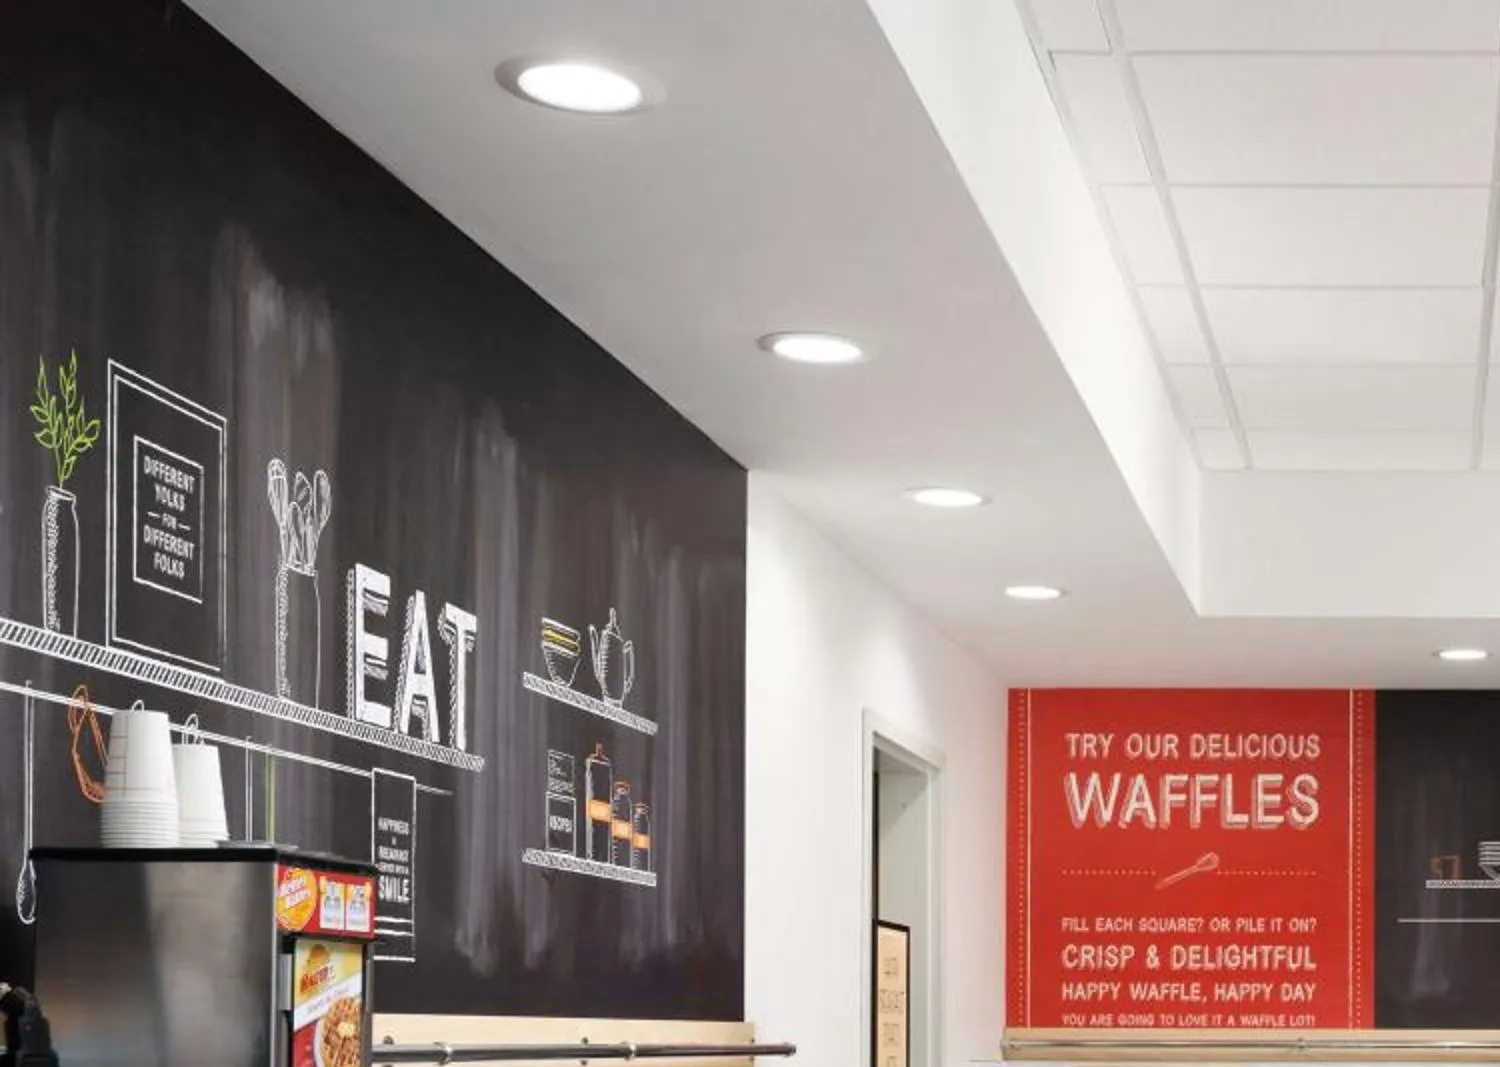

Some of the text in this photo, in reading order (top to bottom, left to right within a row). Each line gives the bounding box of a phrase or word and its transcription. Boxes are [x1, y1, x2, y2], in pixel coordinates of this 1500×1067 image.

[143, 455, 195, 494] DIFFERENT
[143, 524, 195, 561] DIFFERENT
[154, 551, 185, 580] FOLKS
[347, 562, 478, 751] EAT
[1065, 733, 1321, 761] TRY OUR DELICIOUS
[1064, 772, 1320, 830] WAFFLES
[378, 875, 410, 904] SMILE
[1061, 917, 1318, 933] FILL EACH SQUARE? OR PILE IT ON?
[1062, 943, 1318, 971] CRISP & DELIGHTFUL
[1062, 981, 1317, 1005] HAPPY WAFFLE, HAPPY DAY
[1062, 1013, 1086, 1026] YOU
[1089, 1013, 1114, 1026] ARE
[1159, 1013, 1175, 1026] TO
[1211, 1013, 1222, 1026] IT
[1226, 1013, 1236, 1026] A
